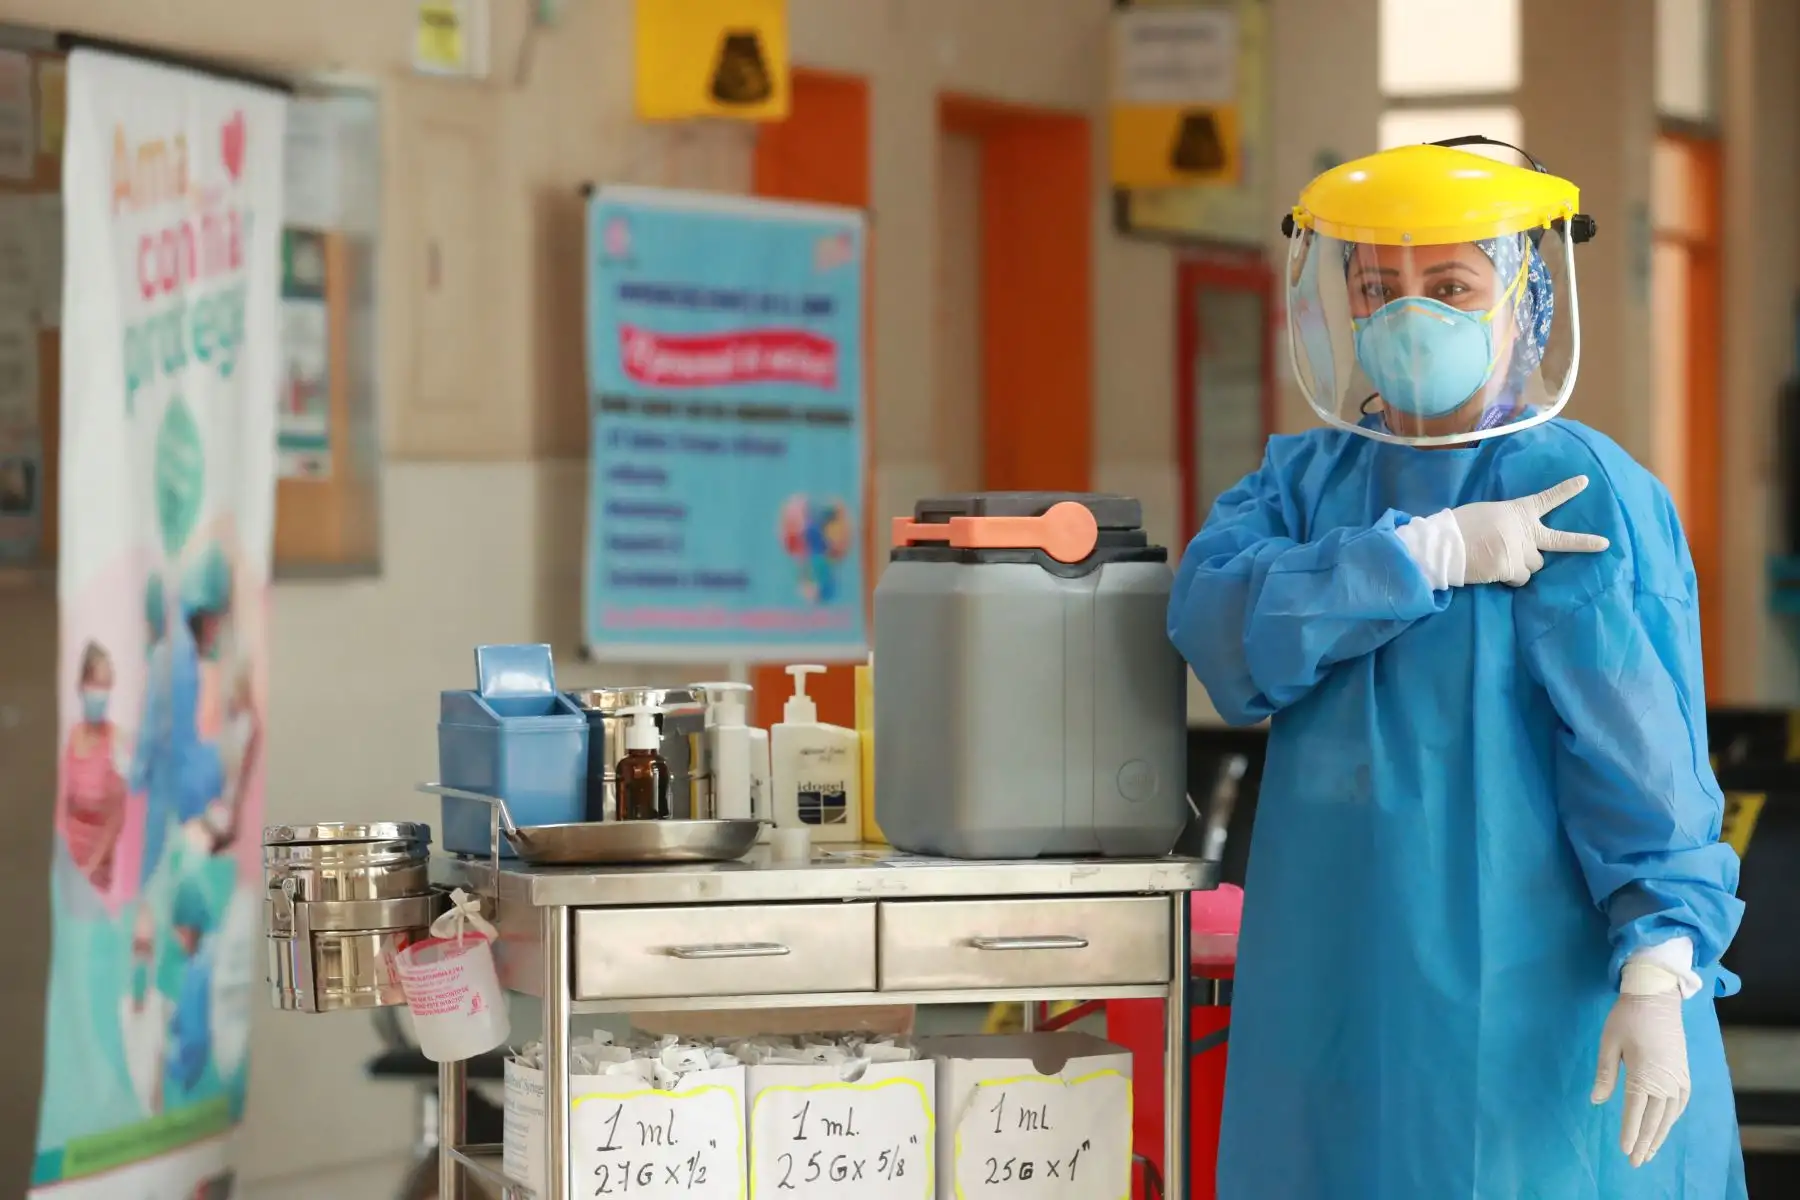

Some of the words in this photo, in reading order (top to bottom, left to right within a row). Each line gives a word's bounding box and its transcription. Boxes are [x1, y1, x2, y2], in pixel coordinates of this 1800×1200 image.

[596, 1103, 623, 1152] 1
[792, 1100, 810, 1141] 1
[990, 1092, 1006, 1134] 1
